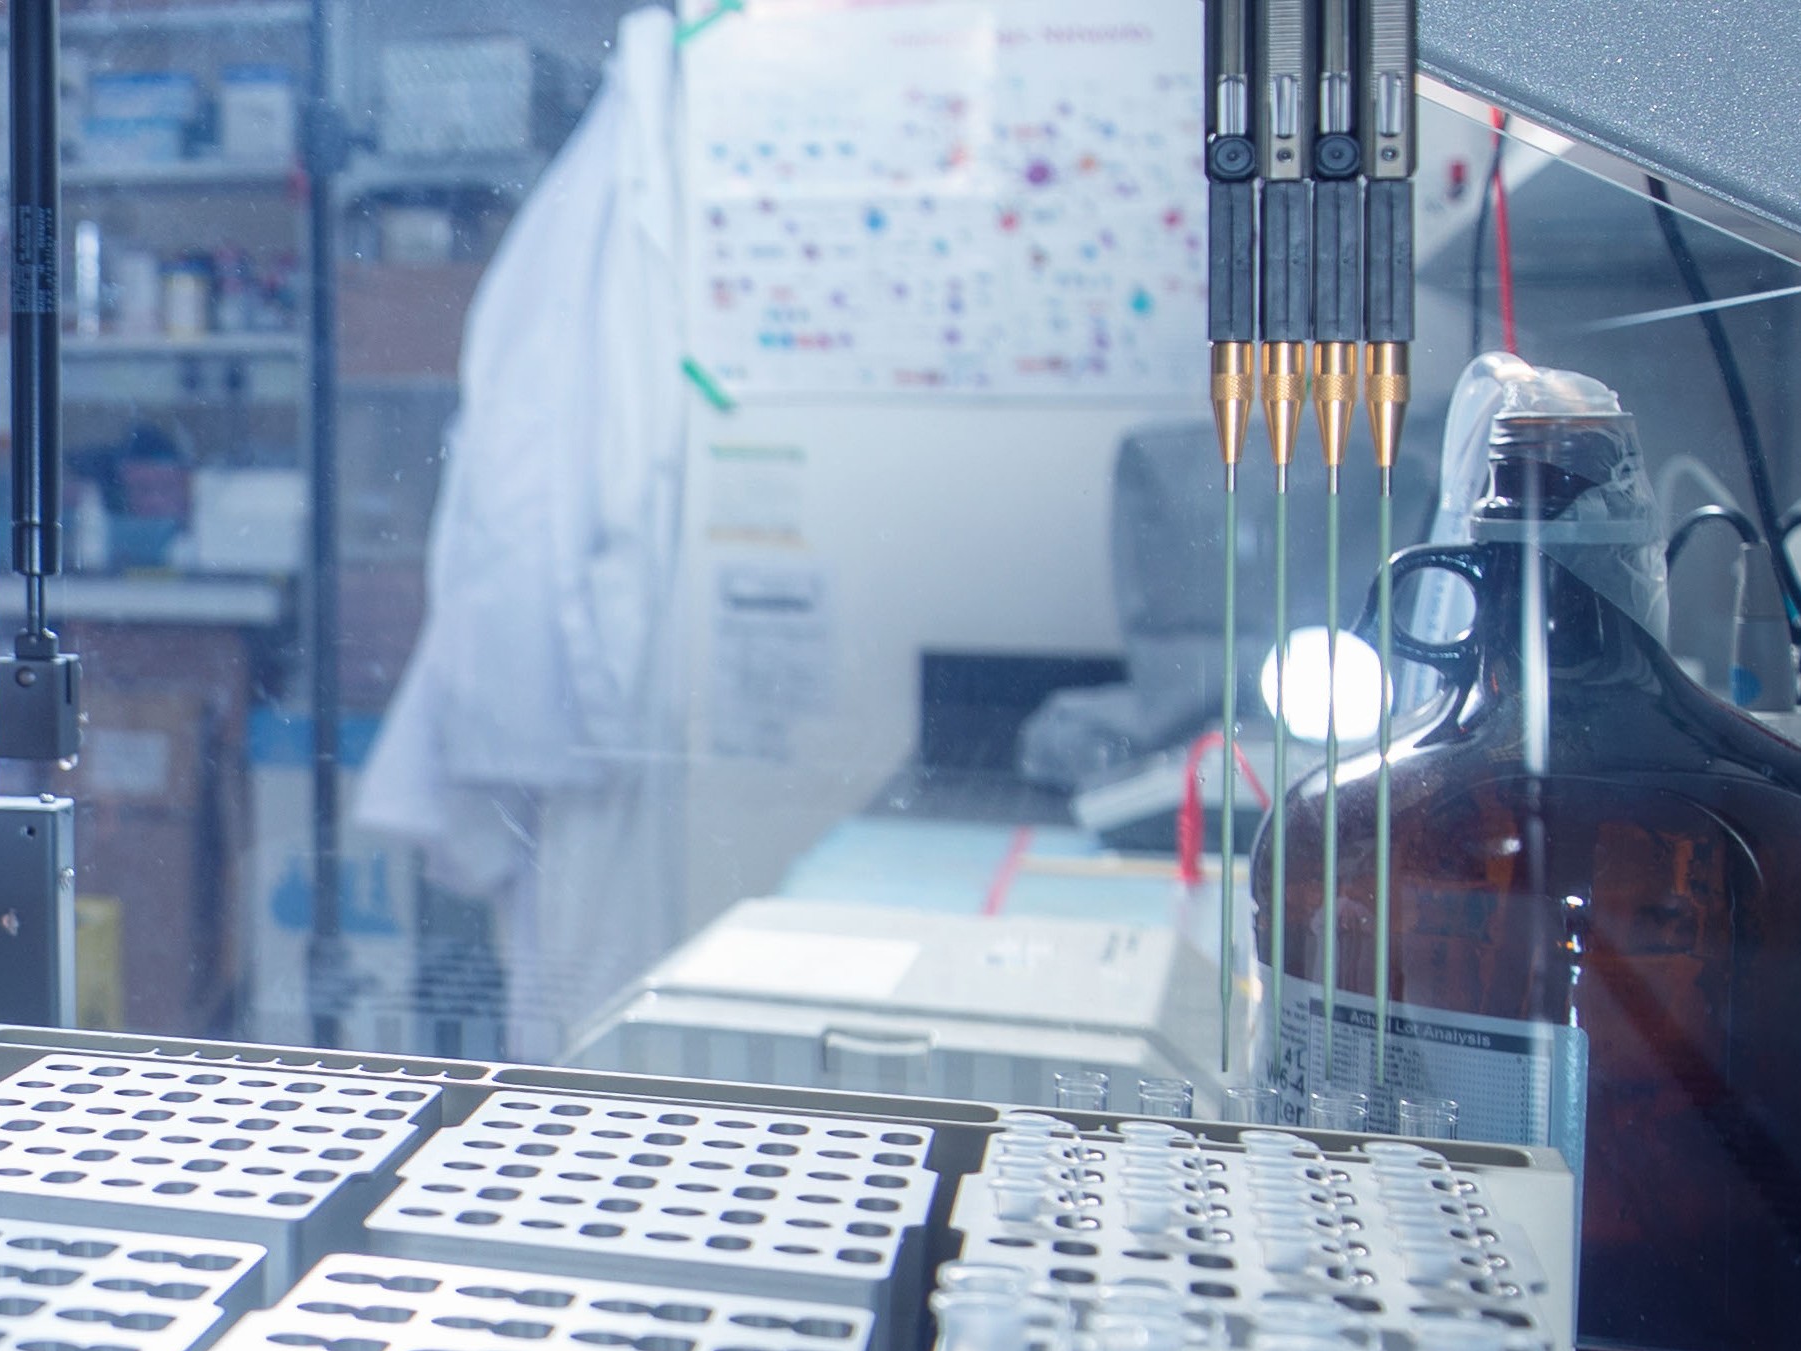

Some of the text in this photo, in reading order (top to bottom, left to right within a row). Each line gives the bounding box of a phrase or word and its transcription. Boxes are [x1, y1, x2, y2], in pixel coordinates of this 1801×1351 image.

[1397, 1019, 1418, 1036] Lot
[1424, 1027, 1491, 1048] Analysis
[1297, 1050, 1306, 1071] L
